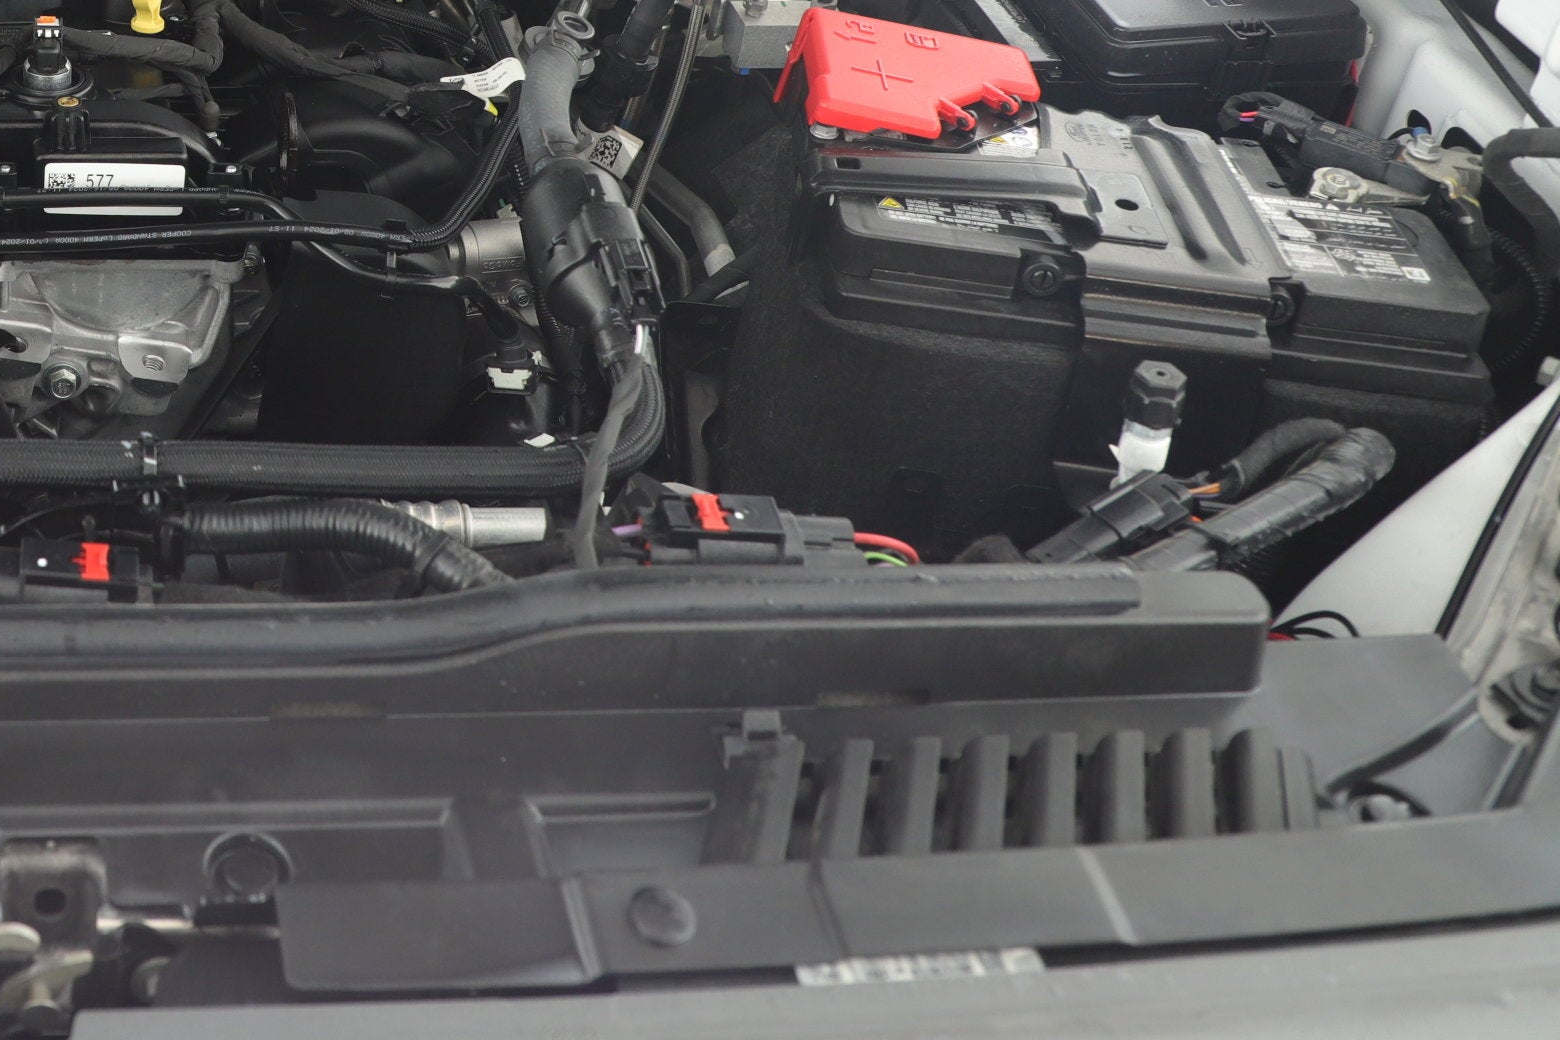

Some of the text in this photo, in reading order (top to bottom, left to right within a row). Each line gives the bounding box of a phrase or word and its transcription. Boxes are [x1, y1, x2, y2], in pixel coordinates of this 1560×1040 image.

[86, 174, 114, 188] 577
[118, 232, 157, 240] STANDARD
[161, 230, 192, 238] COOPER
